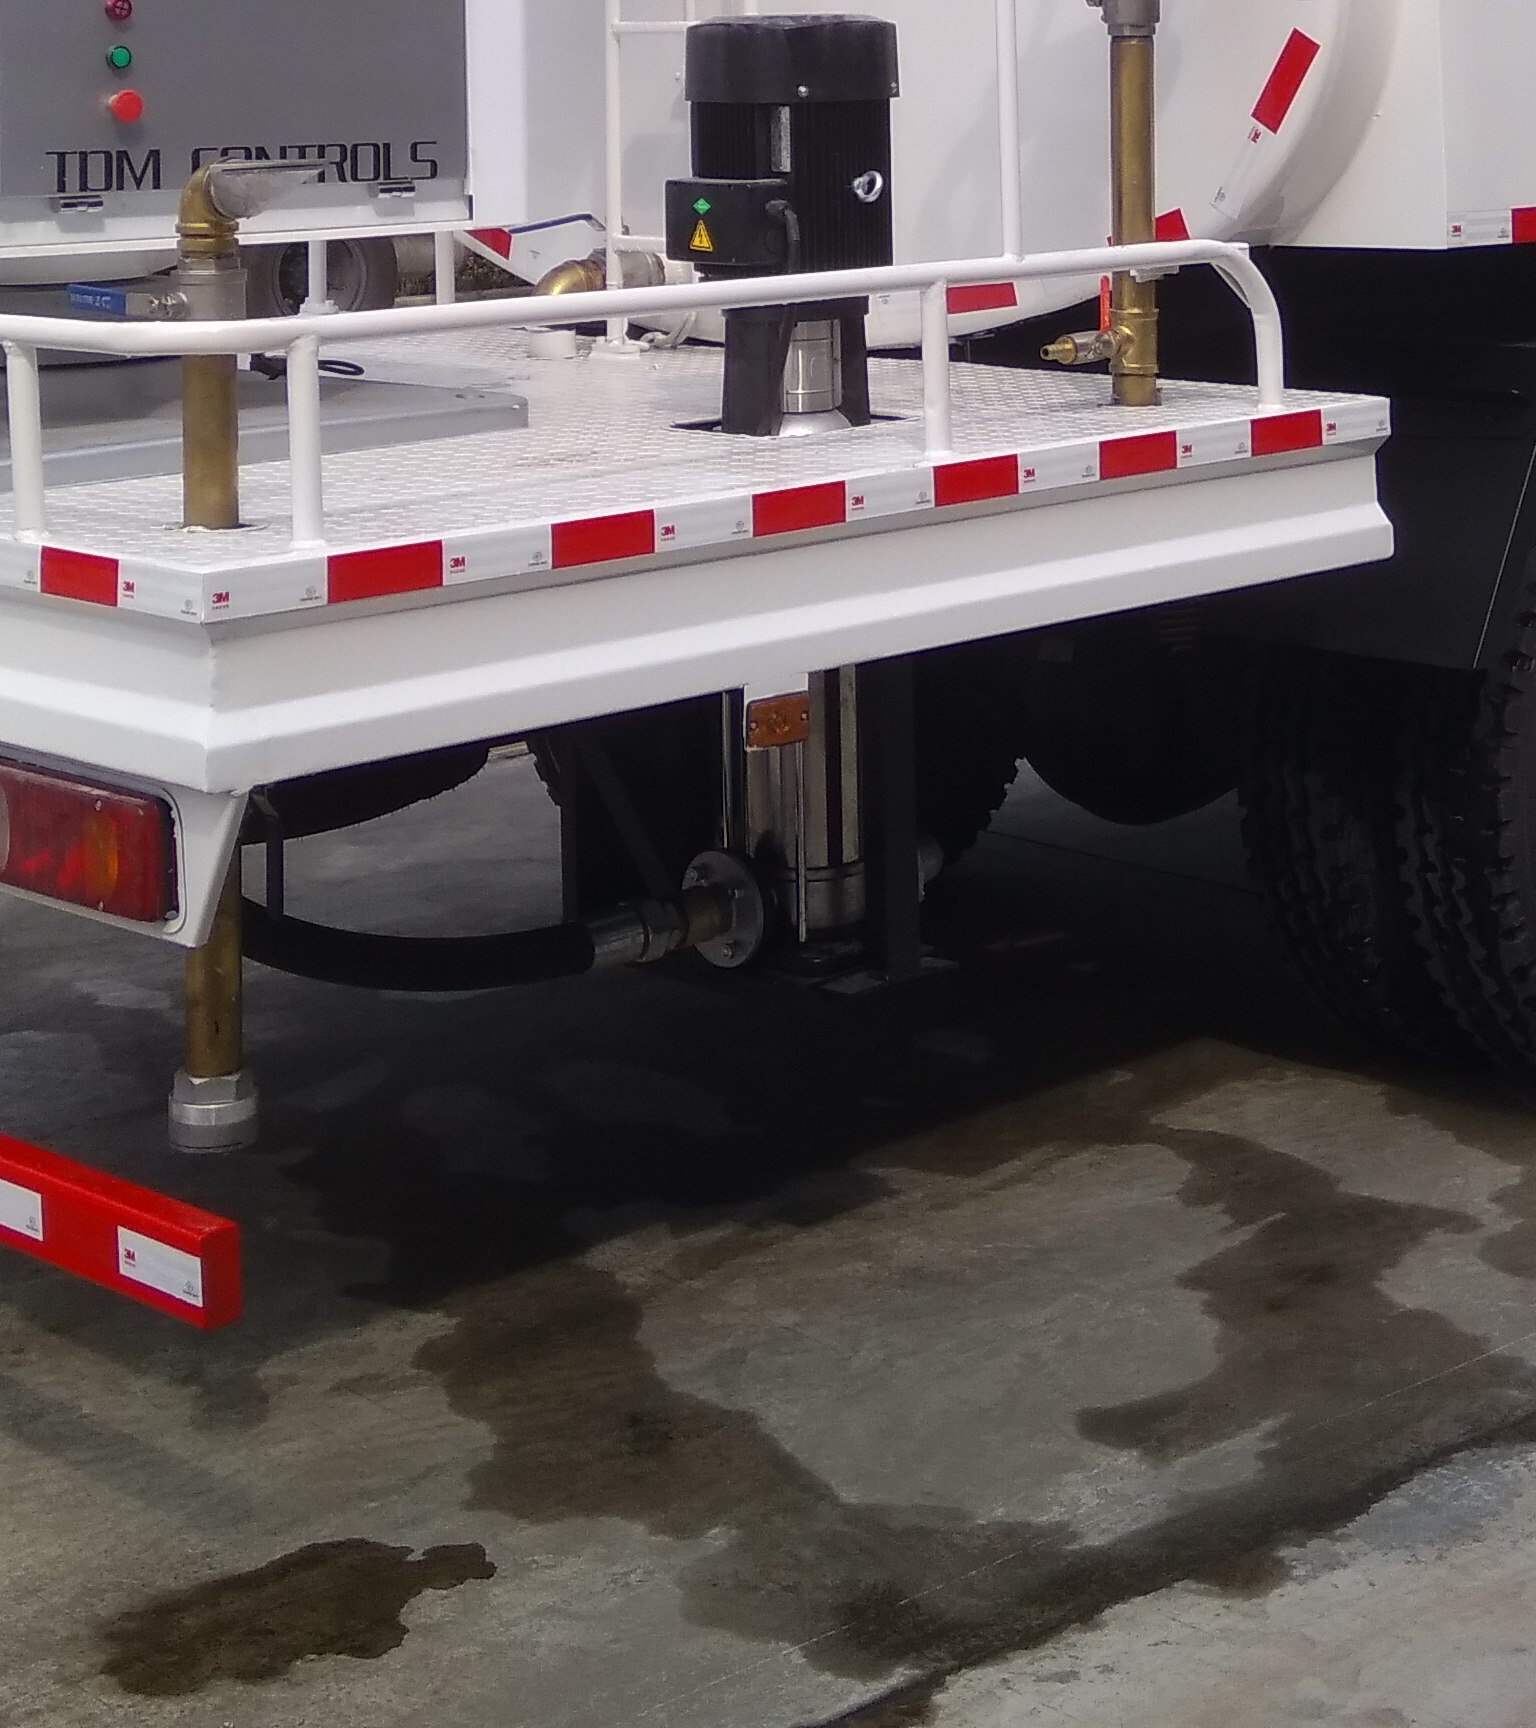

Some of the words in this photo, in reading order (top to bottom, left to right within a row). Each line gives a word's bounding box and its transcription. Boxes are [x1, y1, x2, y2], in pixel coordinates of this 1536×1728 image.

[46, 148, 162, 193] TDM
[661, 525, 675, 537] 3M
[450, 556, 466, 569] 3M
[212, 592, 229, 604] 3M
